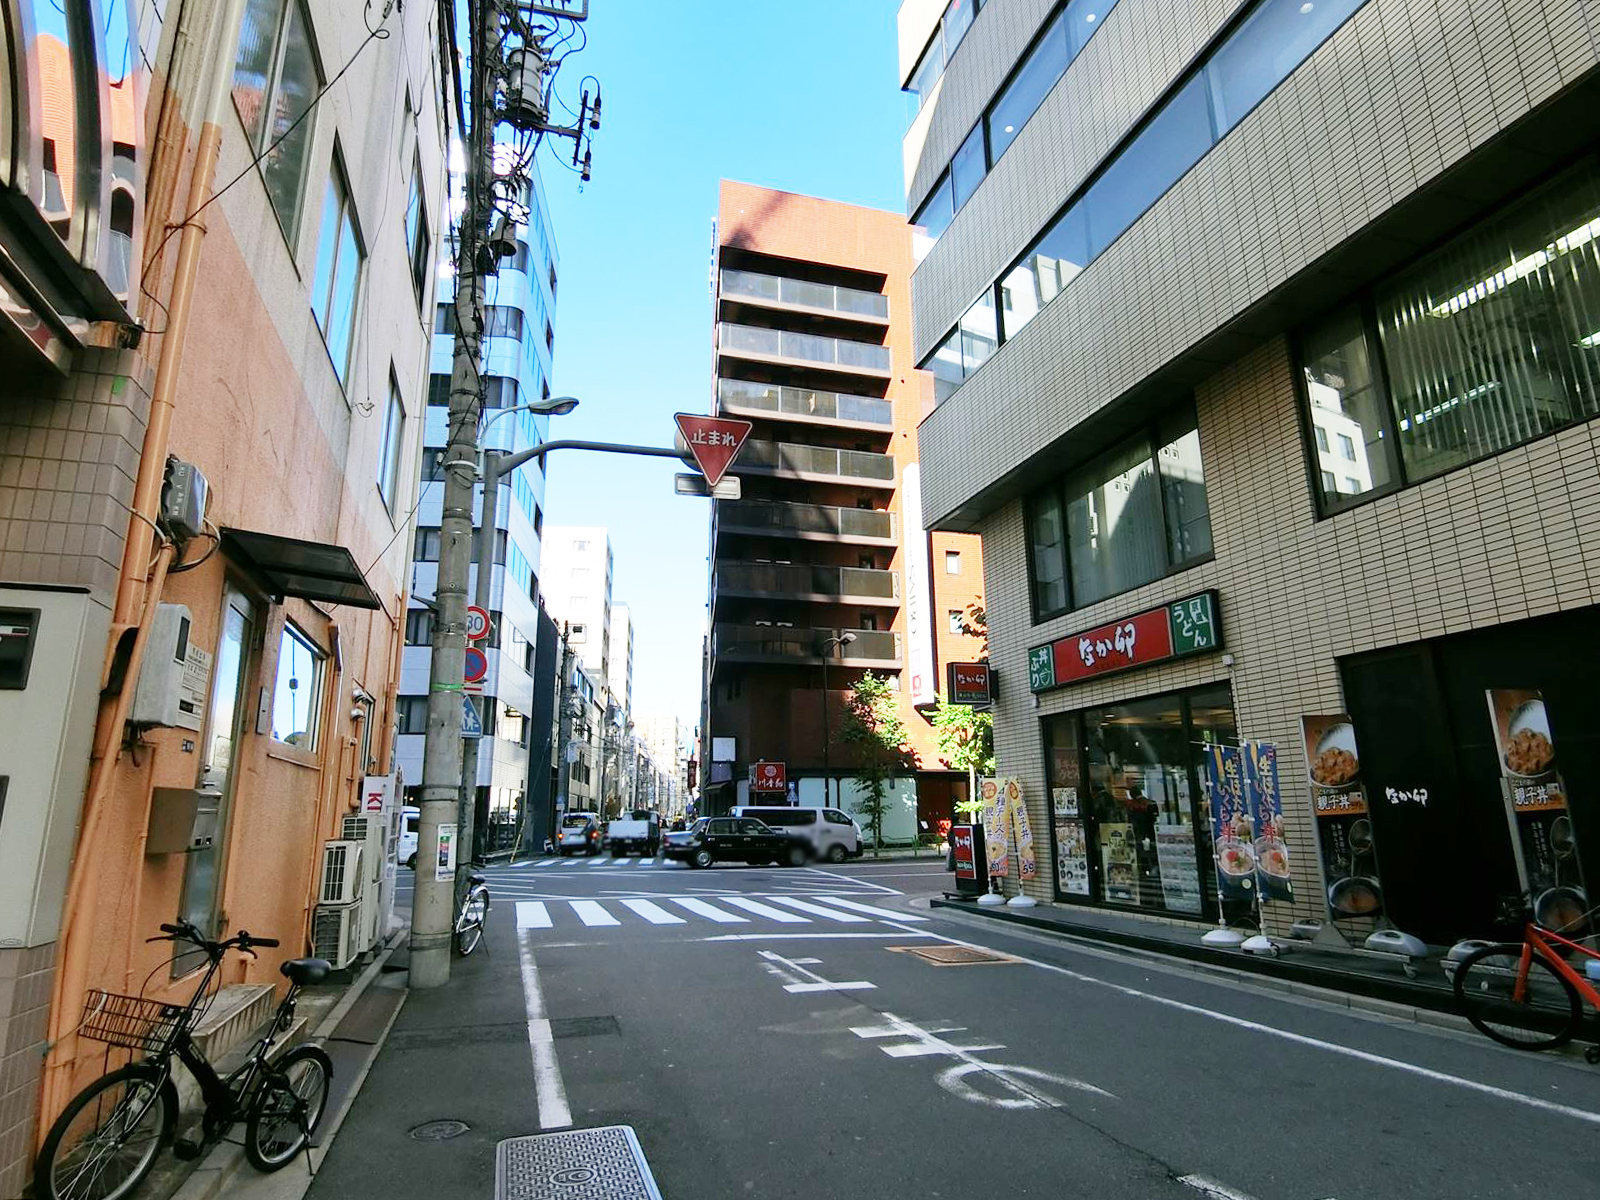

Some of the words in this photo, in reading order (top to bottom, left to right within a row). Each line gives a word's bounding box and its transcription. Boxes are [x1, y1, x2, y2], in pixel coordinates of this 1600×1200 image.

[691, 428, 737, 447] 止まれ
[468, 615, 483, 631] 30
[1173, 605, 1207, 648] うどん
[1078, 622, 1136, 667] なか卯
[1316, 794, 1350, 811] 親子丼
[1385, 786, 1428, 807] なか卯
[1514, 785, 1549, 806] 親子丼
